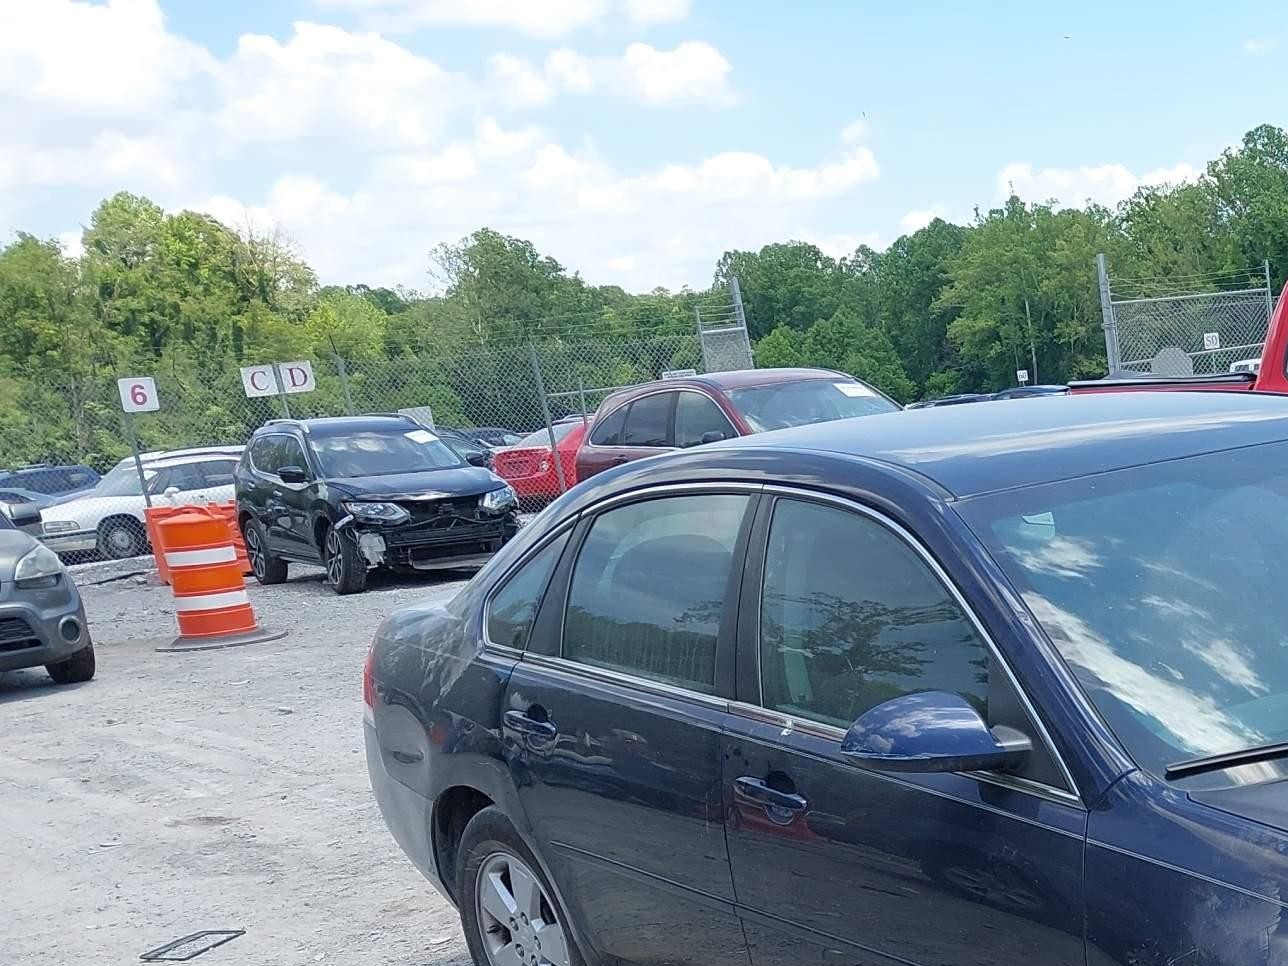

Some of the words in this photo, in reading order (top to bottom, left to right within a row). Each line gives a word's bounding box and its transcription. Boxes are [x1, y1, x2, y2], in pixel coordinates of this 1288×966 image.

[250, 370, 270, 391] C
[286, 366, 308, 388] D
[130, 384, 148, 406] 6
